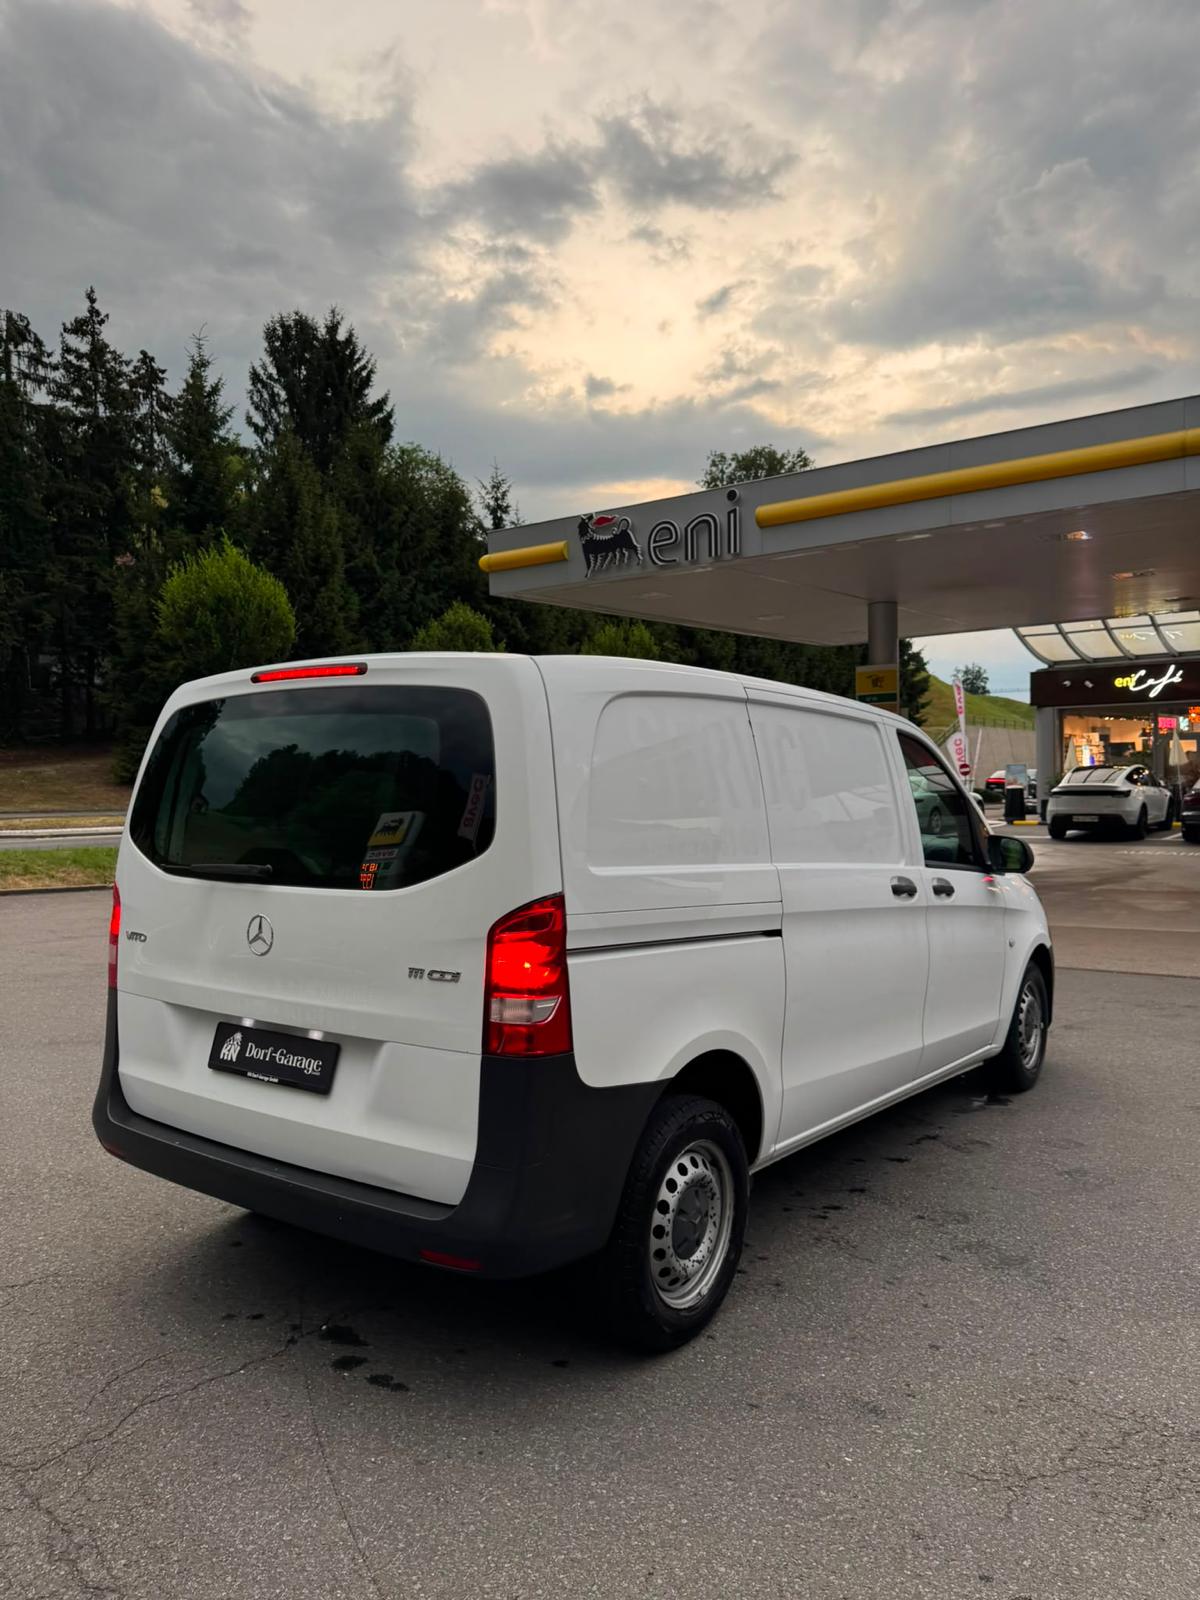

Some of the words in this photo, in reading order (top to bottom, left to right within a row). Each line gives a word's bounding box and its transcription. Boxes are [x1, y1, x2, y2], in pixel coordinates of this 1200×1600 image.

[648, 489, 740, 565] eni
[1114, 673, 1136, 688] eni
[125, 930, 148, 943] VITO
[427, 969, 462, 983] CDI
[245, 1041, 323, 1076] Dorf-Garage
